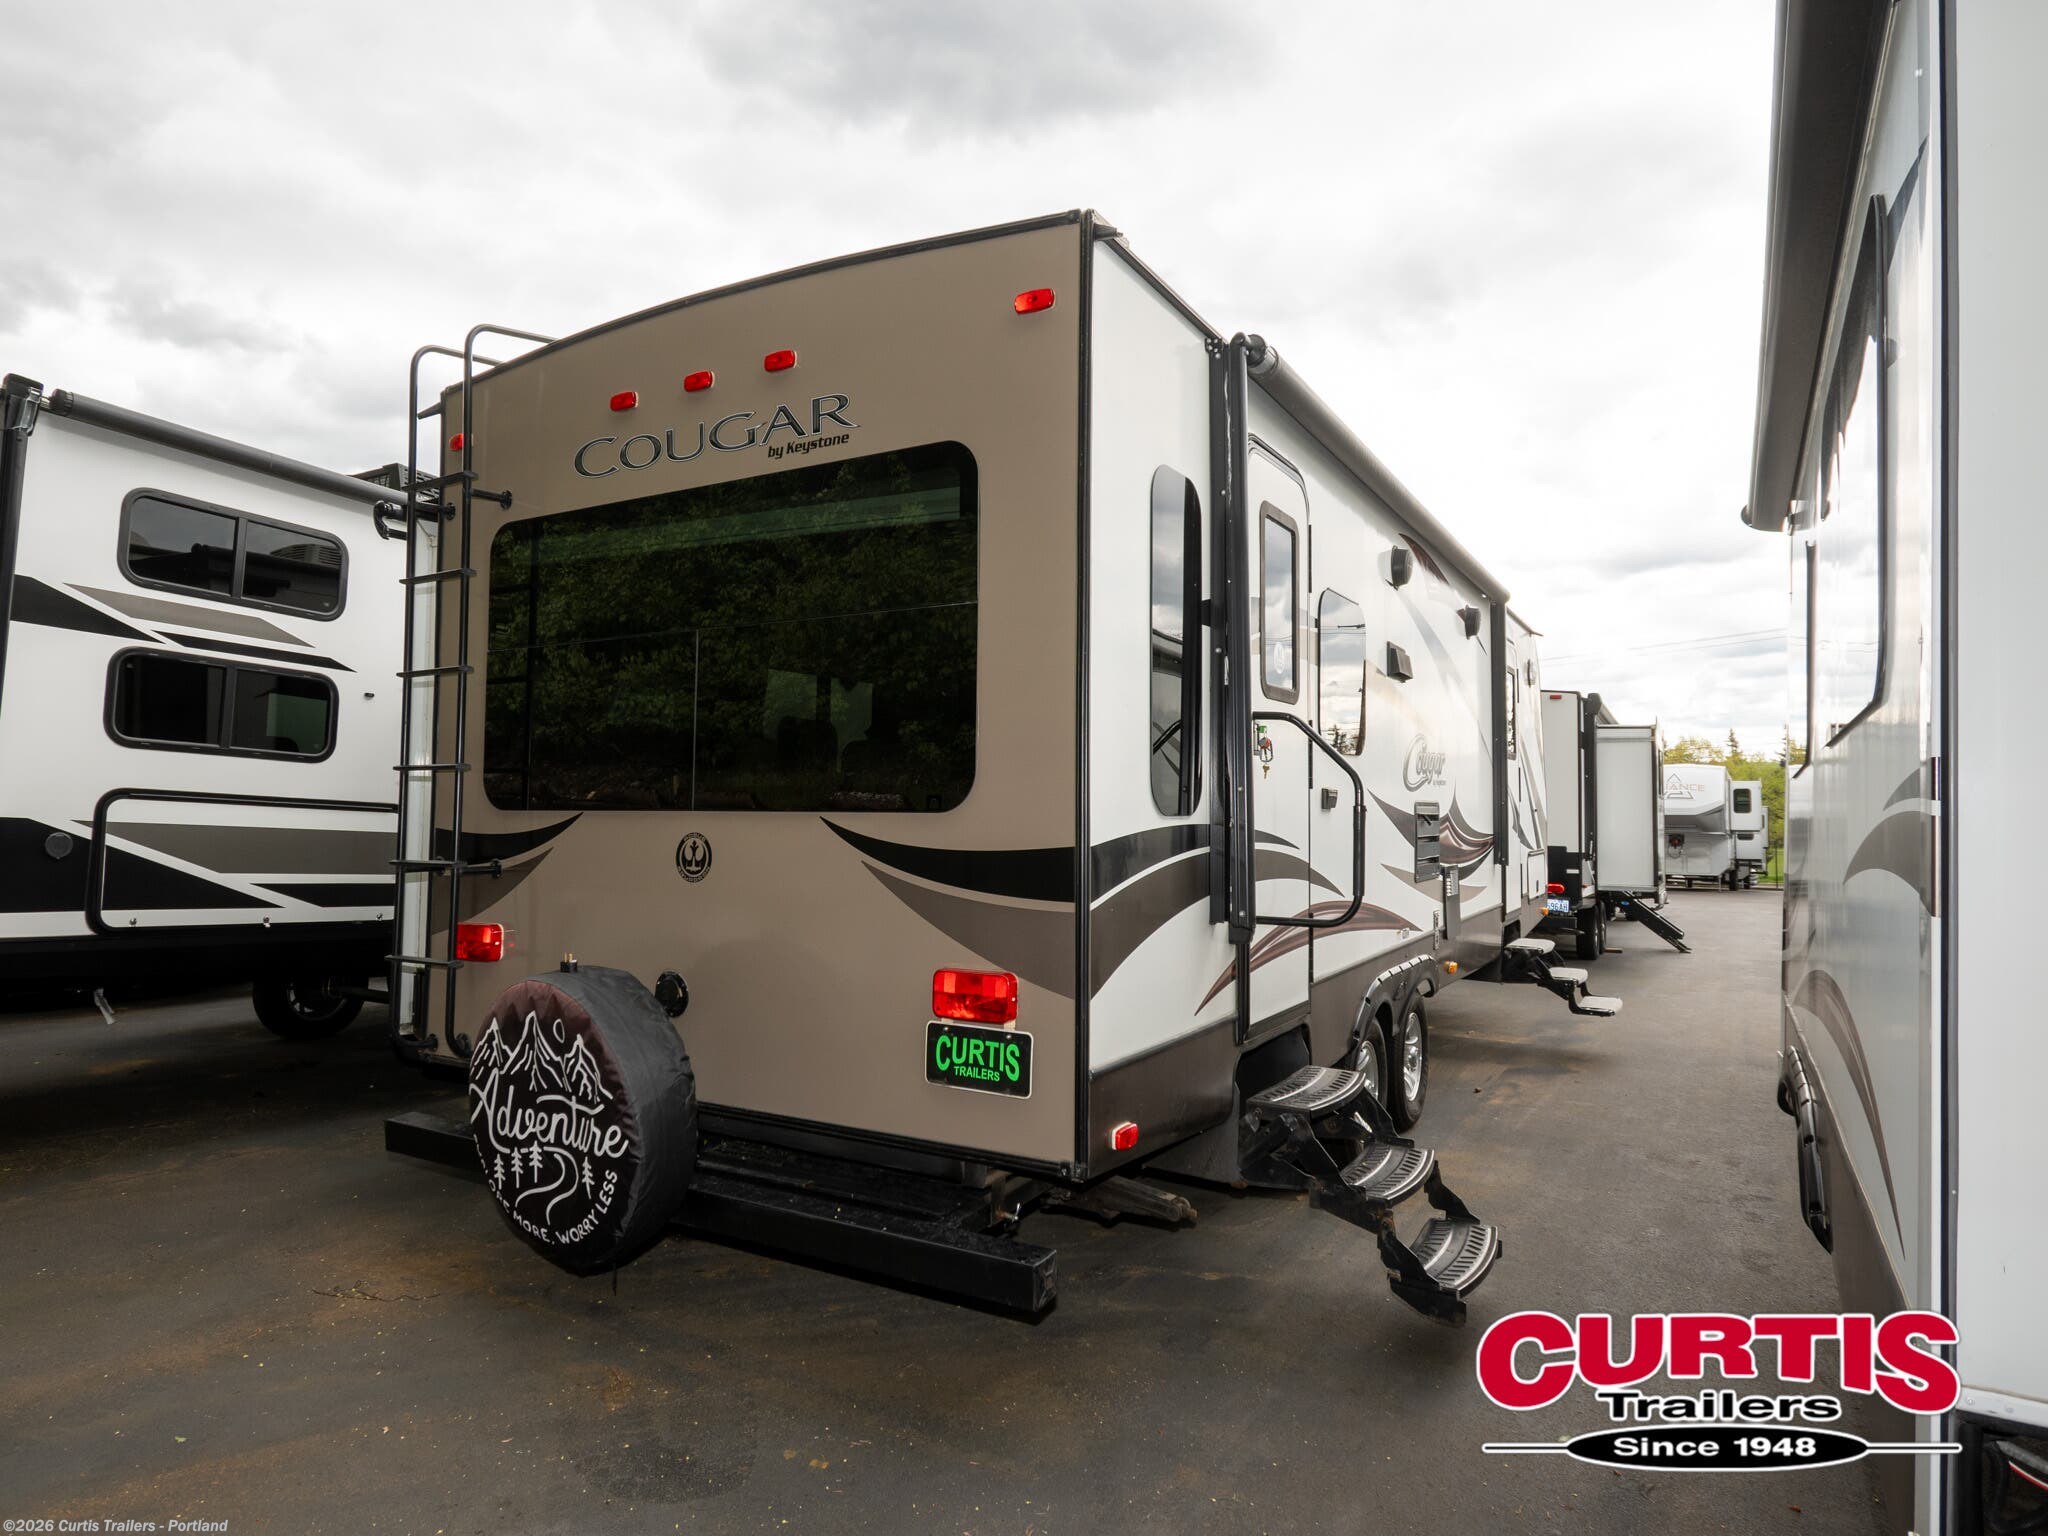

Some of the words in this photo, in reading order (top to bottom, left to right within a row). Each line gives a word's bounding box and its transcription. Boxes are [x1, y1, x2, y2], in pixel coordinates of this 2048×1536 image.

[574, 393, 861, 479] COUGAR
[767, 445, 784, 459] by
[786, 433, 850, 455] Keystone
[935, 1035, 1020, 1082] CURTIS
[953, 1065, 1000, 1082] TRAILERS
[469, 1068, 630, 1158] Adventure
[555, 1209, 599, 1244] WORRY
[595, 1169, 618, 1214] LESS
